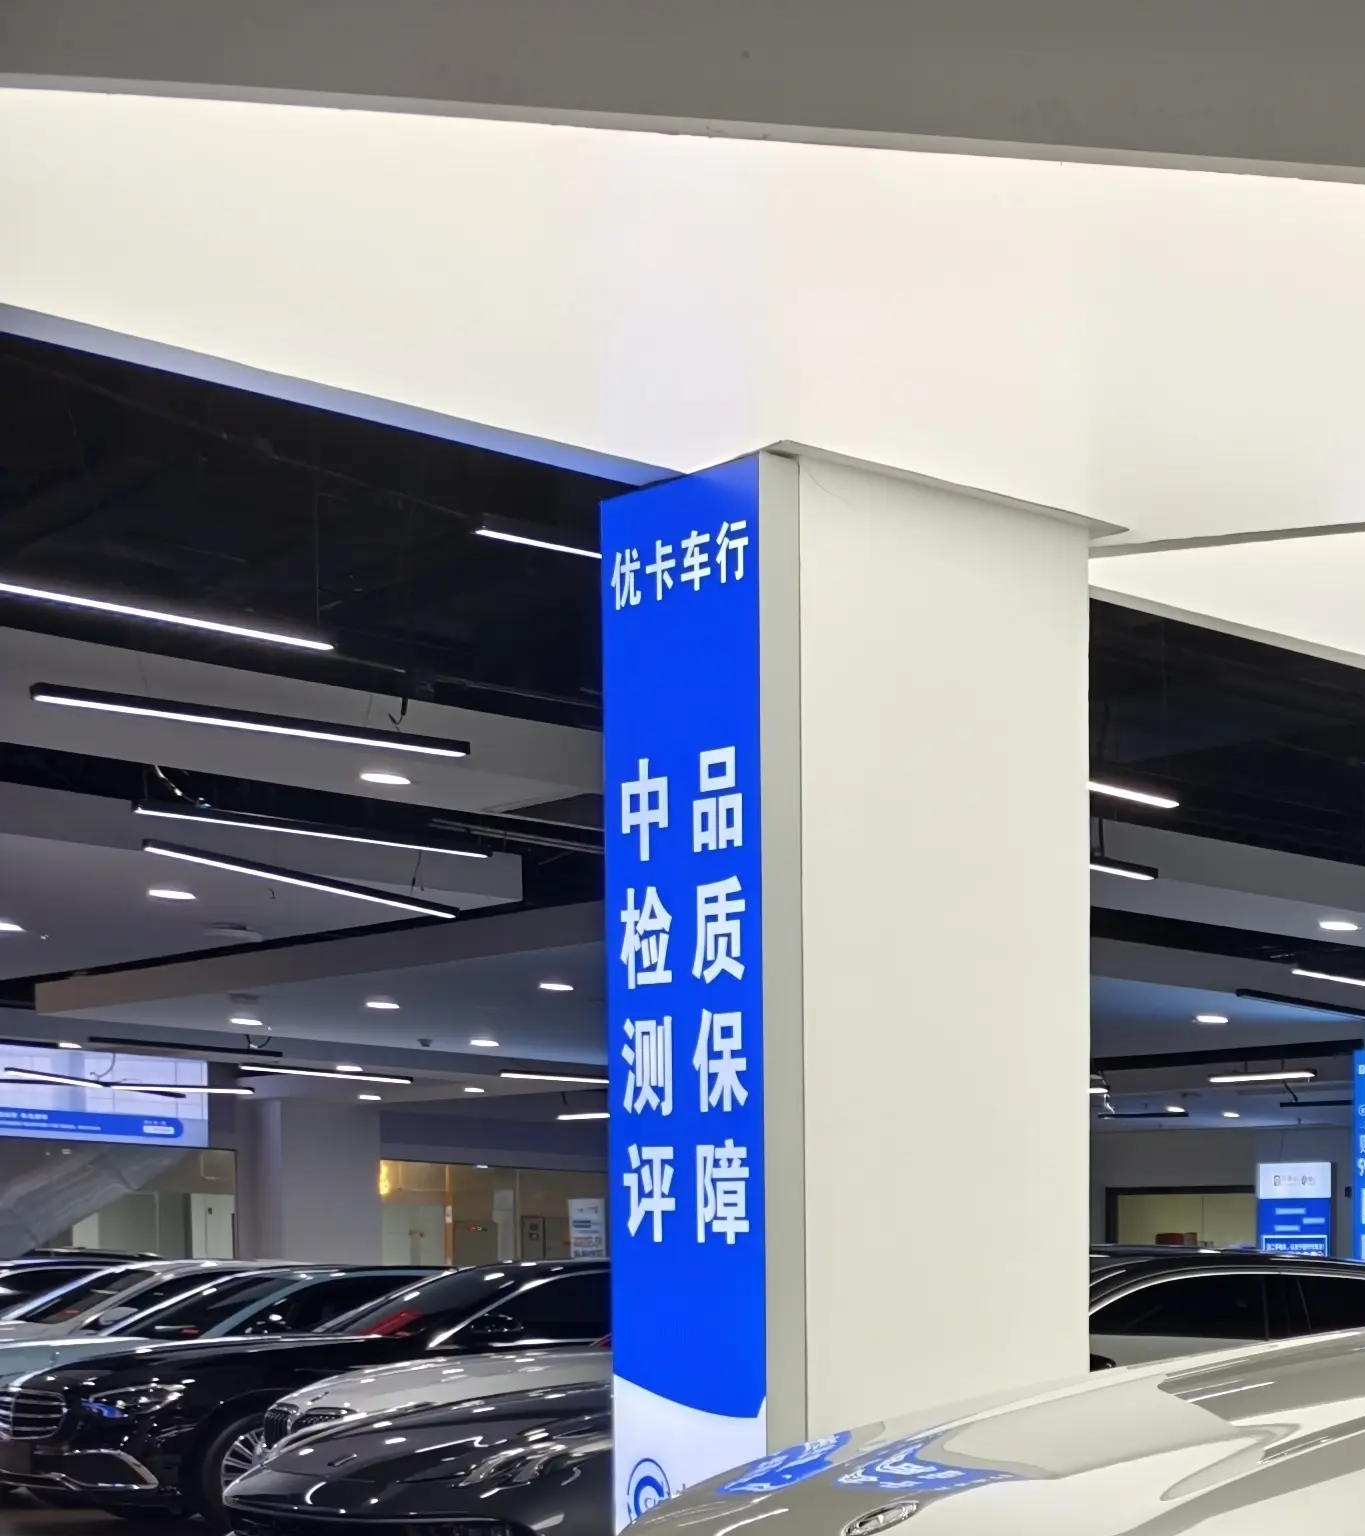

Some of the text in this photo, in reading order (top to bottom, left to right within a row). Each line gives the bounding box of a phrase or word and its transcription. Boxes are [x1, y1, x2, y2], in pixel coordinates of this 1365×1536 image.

[610, 519, 749, 611] 优卡车行
[620, 757, 676, 1244] 中检测评
[691, 745, 750, 1245] 品质保障
